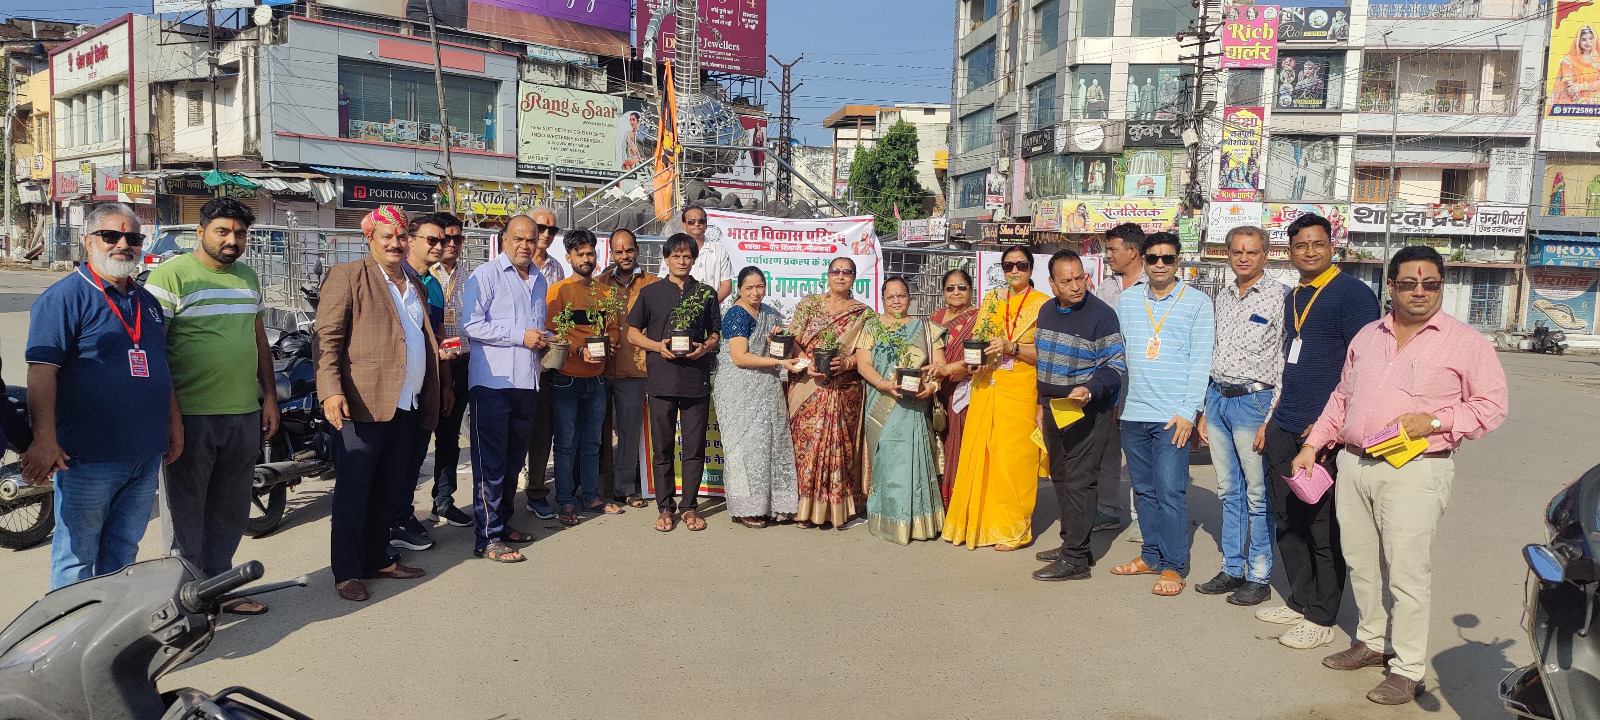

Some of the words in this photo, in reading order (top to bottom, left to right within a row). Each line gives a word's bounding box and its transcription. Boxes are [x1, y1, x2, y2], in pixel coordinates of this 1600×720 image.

[1227, 22, 1275, 42] Rich
[703, 37, 740, 51] Jewellers
[1224, 42, 1274, 61] पार्लर
[520, 91, 570, 117] Rang
[571, 102, 580, 114] &
[581, 99, 618, 120] Saar
[369, 188, 428, 201] PORTRONICS
[727, 227, 760, 241] भारत
[760, 225, 804, 242] विकास
[999, 224, 1014, 236] Shoe
[745, 255, 782, 265] पर्यावरण
[783, 257, 810, 266] प्रकल्प
[811, 256, 821, 266] के
